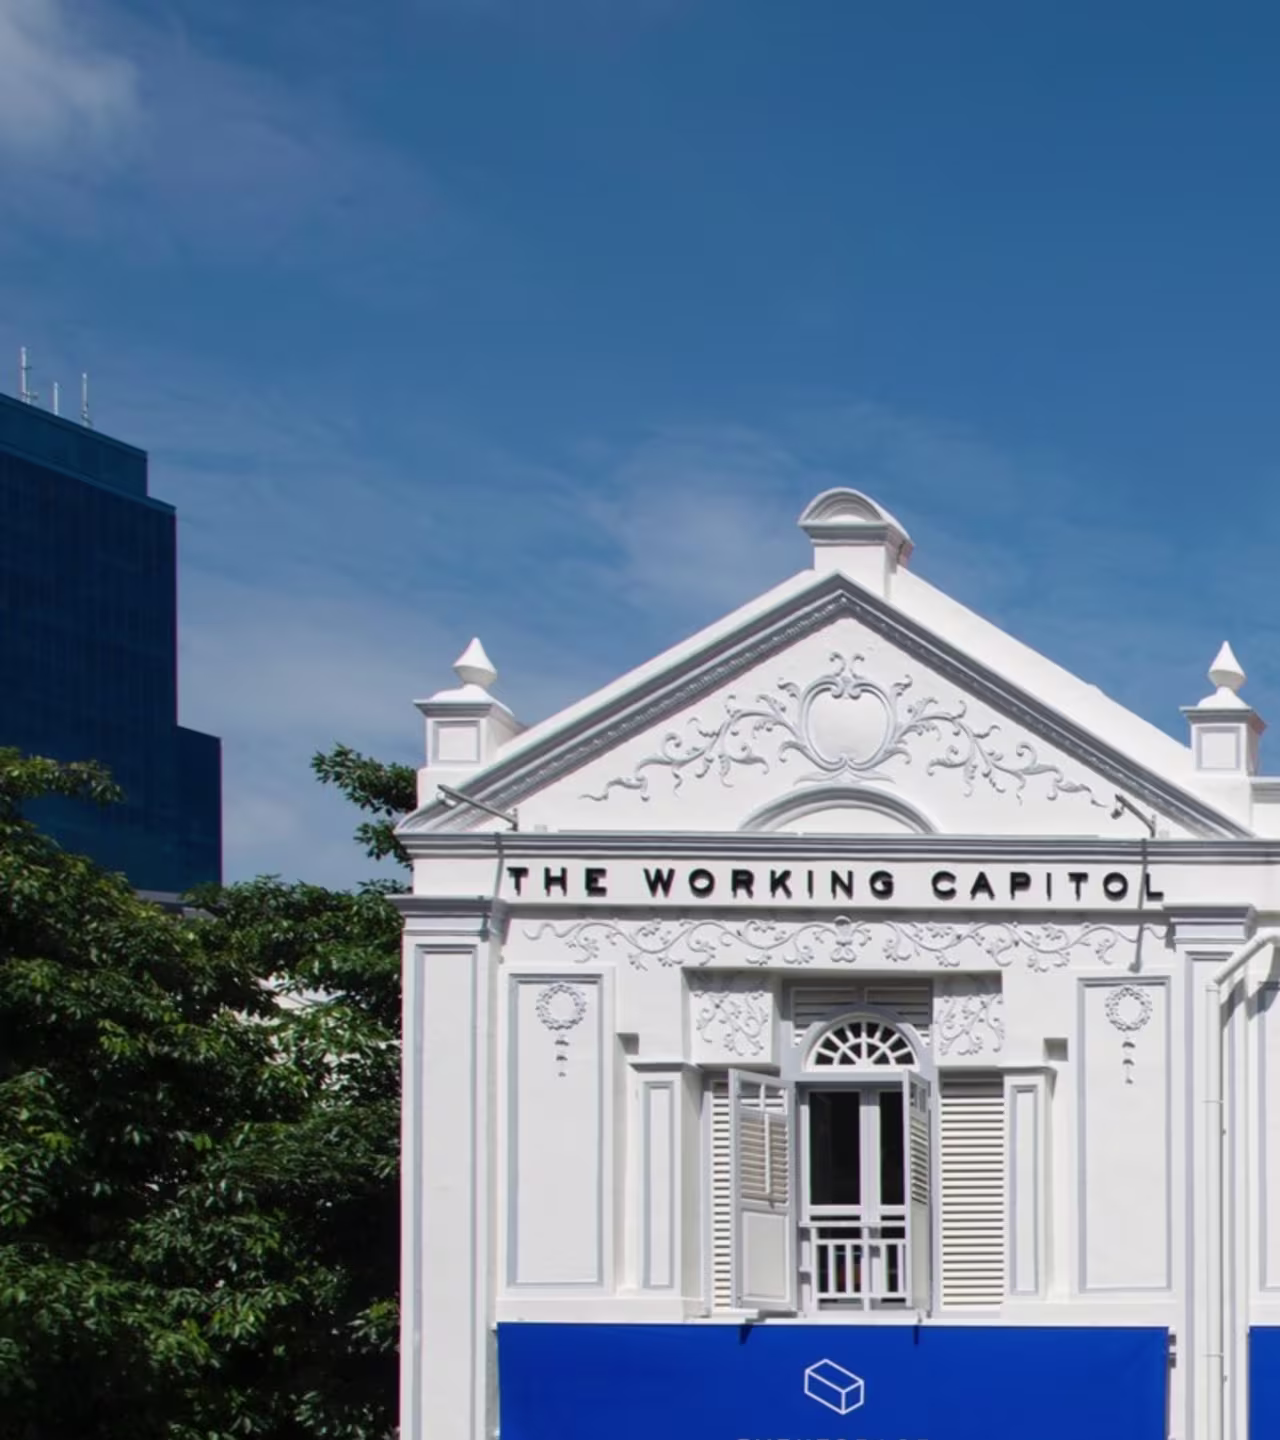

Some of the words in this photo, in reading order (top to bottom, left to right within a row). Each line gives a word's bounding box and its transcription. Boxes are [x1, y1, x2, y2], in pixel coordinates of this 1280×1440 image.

[507, 867, 608, 896] THE
[643, 868, 896, 898] WORKING
[931, 870, 1164, 900] CAPITOL
